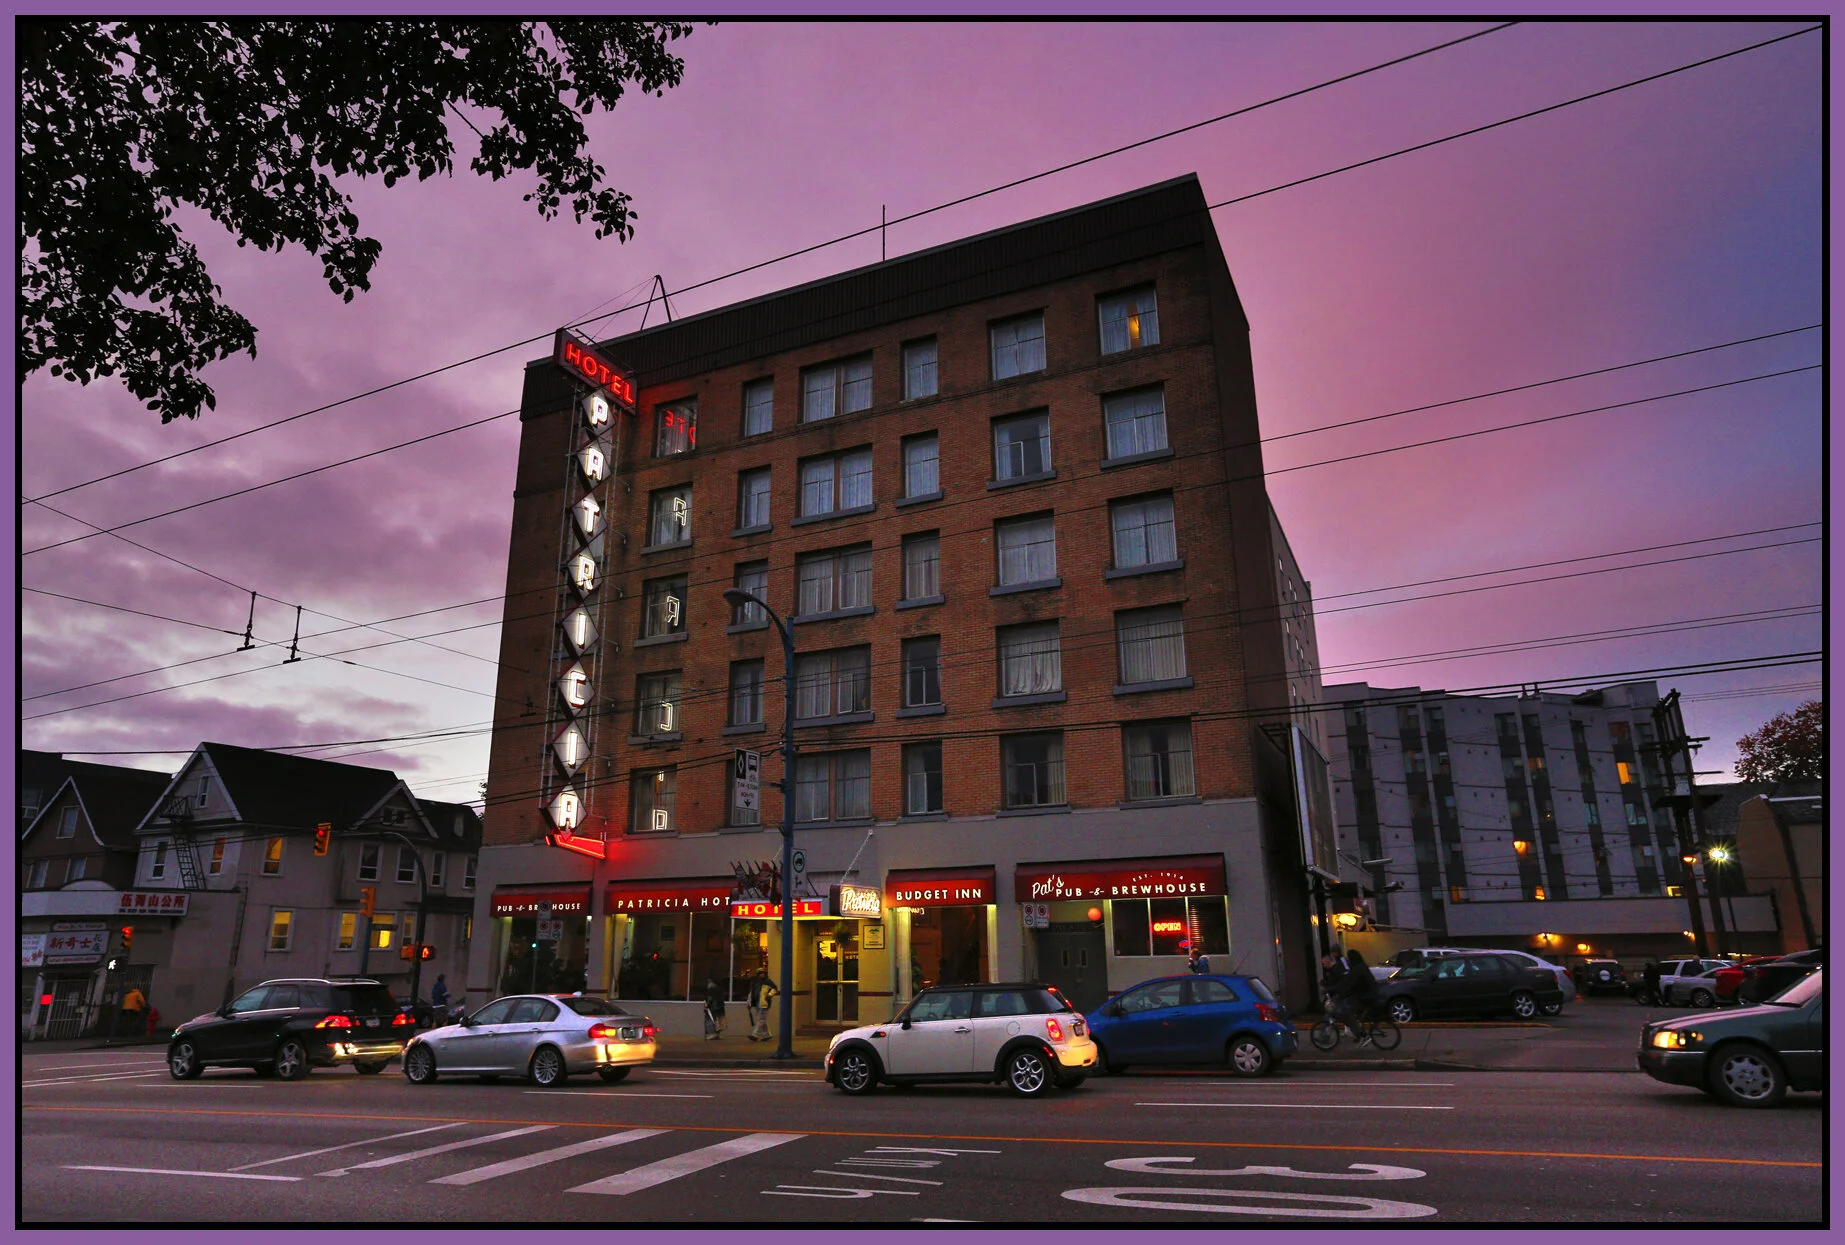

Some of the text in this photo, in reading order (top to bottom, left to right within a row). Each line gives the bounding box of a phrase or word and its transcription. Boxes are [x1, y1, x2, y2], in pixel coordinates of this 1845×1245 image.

[565, 341, 634, 404] HOTEL
[558, 395, 609, 832] PATRICIA
[1032, 875, 1064, 898] Pat's
[1056, 888, 1083, 897] PUB
[1112, 882, 1206, 895] BREWHOUSE
[896, 888, 983, 901] BUDGET INN
[497, 904, 513, 912] PUB
[528, 902, 581, 912] BRHOUSE
[617, 896, 730, 909] PATRICIA HOT
[1153, 922, 1181, 932] OPEN
[1060, 1156, 1438, 1219] 30
